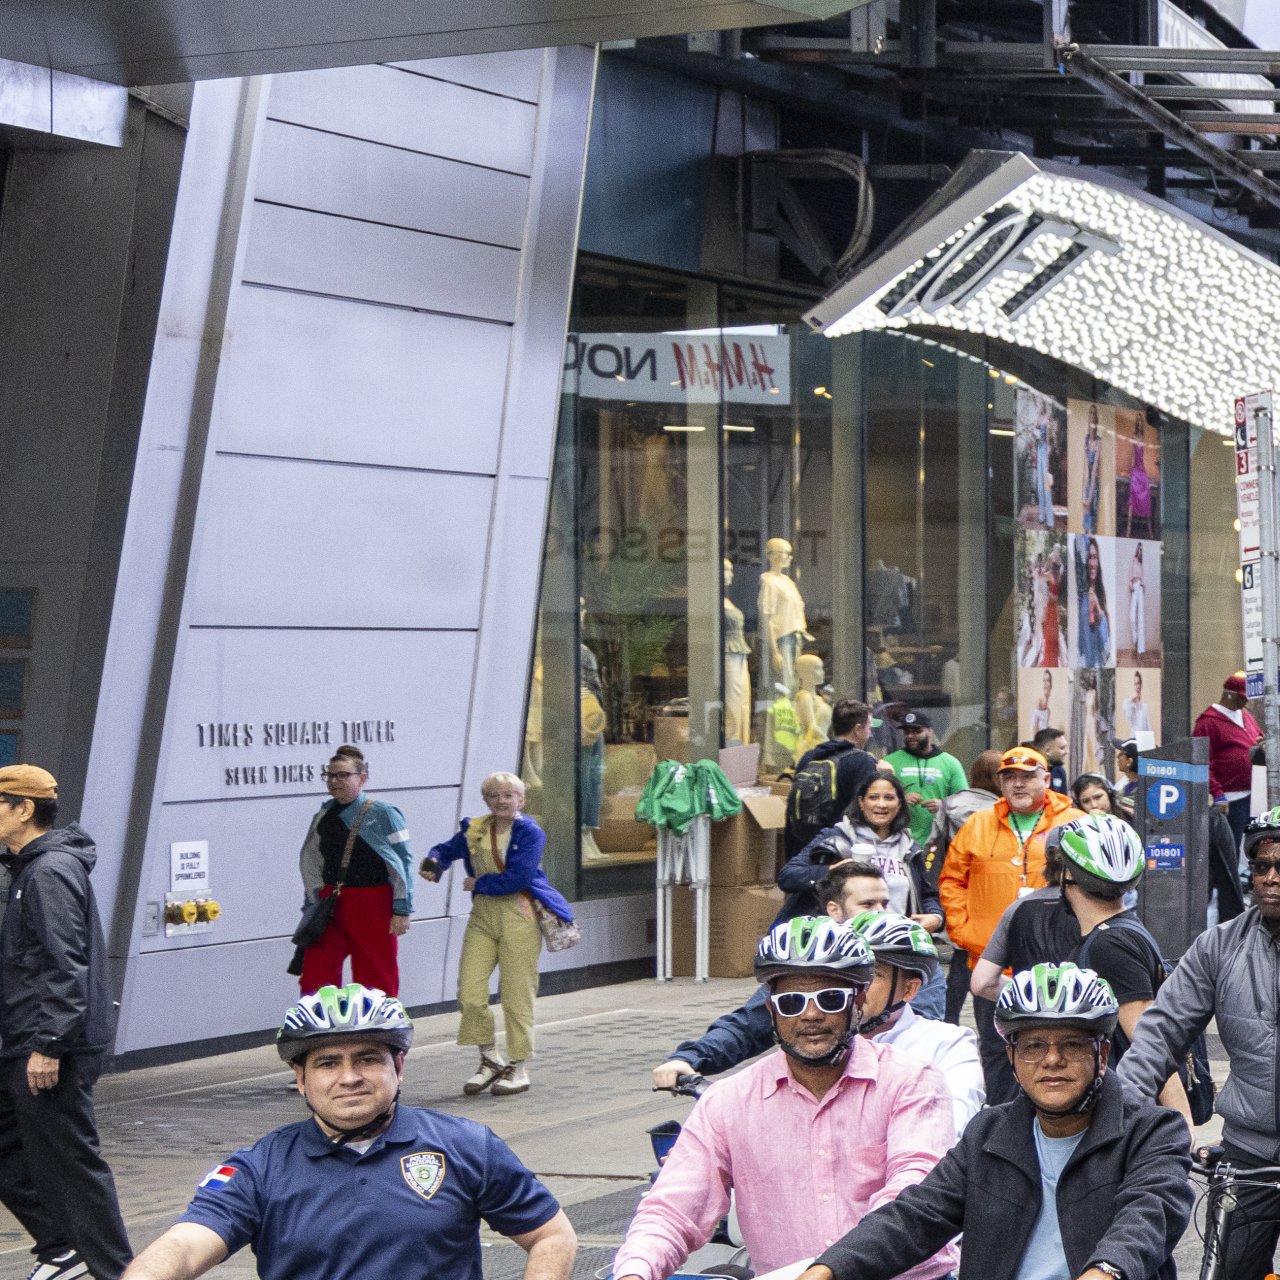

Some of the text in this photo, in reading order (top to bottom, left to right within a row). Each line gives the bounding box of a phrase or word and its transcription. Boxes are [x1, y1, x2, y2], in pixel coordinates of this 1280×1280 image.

[874, 203, 1124, 321] LOFT
[1239, 455, 1248, 472] 3
[1244, 566, 1252, 587] 6
[197, 720, 395, 747] TIMES SQUARE TOWER
[225, 766, 267, 785] SEVEN
[274, 764, 314, 783] TIMES
[1147, 765, 1176, 775] 101801
[1159, 785, 1179, 814] P
[1150, 848, 1180, 857] 101801
